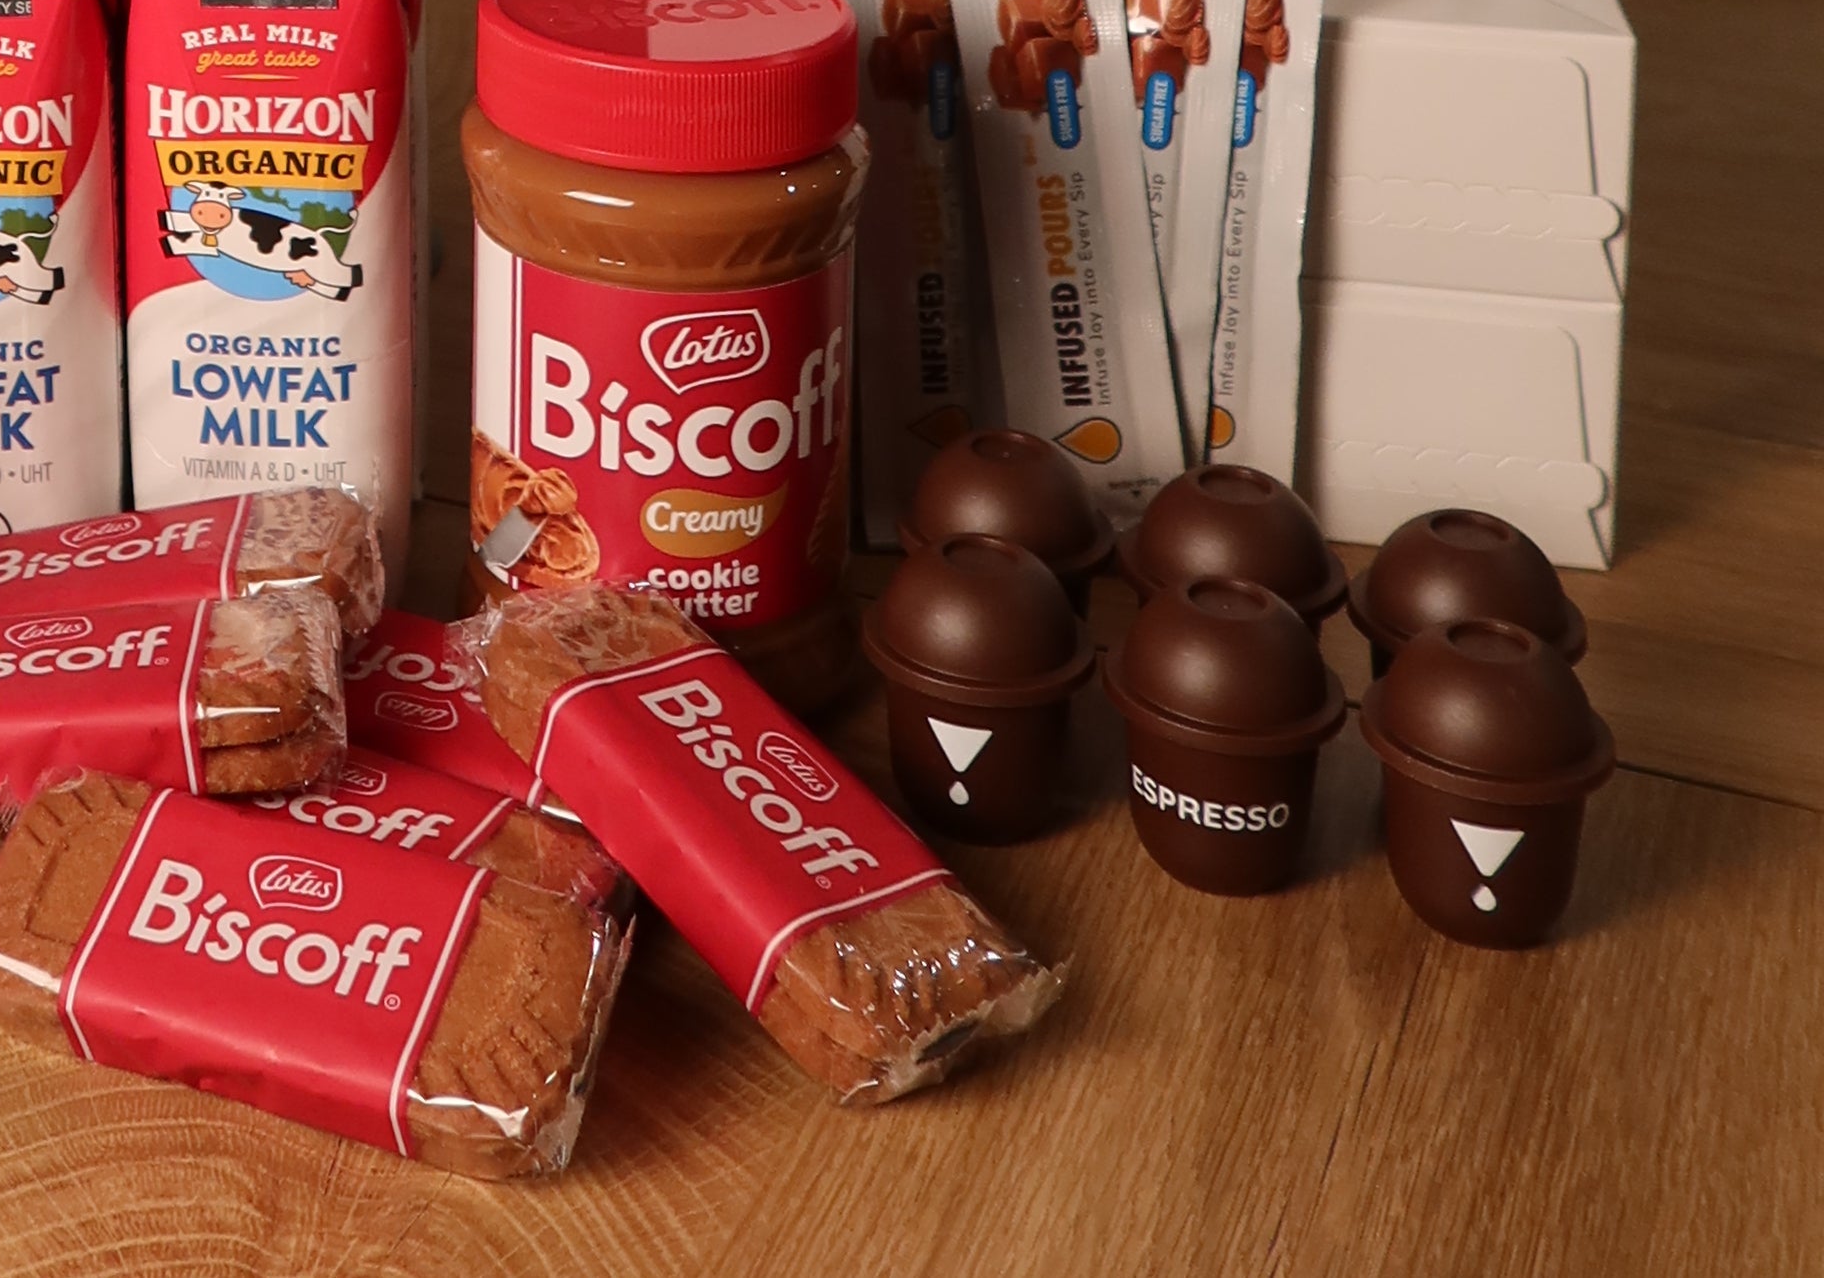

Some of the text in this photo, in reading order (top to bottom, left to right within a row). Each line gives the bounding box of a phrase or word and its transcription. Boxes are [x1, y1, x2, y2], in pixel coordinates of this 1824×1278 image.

[181, 23, 339, 52] REAL MILK
[195, 48, 321, 74] great taste
[146, 83, 375, 143] HORIZON
[1053, 77, 1073, 143] SUGAR FREE
[1149, 78, 1170, 144] SUGAR FREE
[168, 148, 357, 180] ORGANIC
[1070, 171, 1085, 203] Sip
[1148, 172, 1166, 203] Sip
[1231, 170, 1249, 202] Sip
[1076, 208, 1094, 262] Every
[1227, 206, 1248, 259] Every
[1036, 173, 1093, 407] INFUSED POURS
[1083, 268, 1099, 306] into
[1225, 264, 1242, 302] into
[185, 332, 341, 358] ORGANIC
[663, 325, 757, 370] Lotus
[917, 272, 948, 395] INFUSED
[171, 358, 357, 404] LOWFAT
[1093, 347, 1111, 406] Infuse
[1218, 340, 1236, 397] Infuse
[530, 324, 843, 478] Biscoff
[199, 407, 330, 450] MILK
[21, 460, 54, 484] UHT
[182, 456, 347, 482] VITAMIN A & D UHT
[645, 501, 764, 537] Creamy
[648, 559, 760, 590] cookie
[671, 591, 760, 618] utter
[638, 678, 879, 892] Biscoff
[1130, 763, 1290, 832] ESPRESSO
[260, 862, 335, 900] Lotus
[128, 859, 422, 1008] Biscoff
